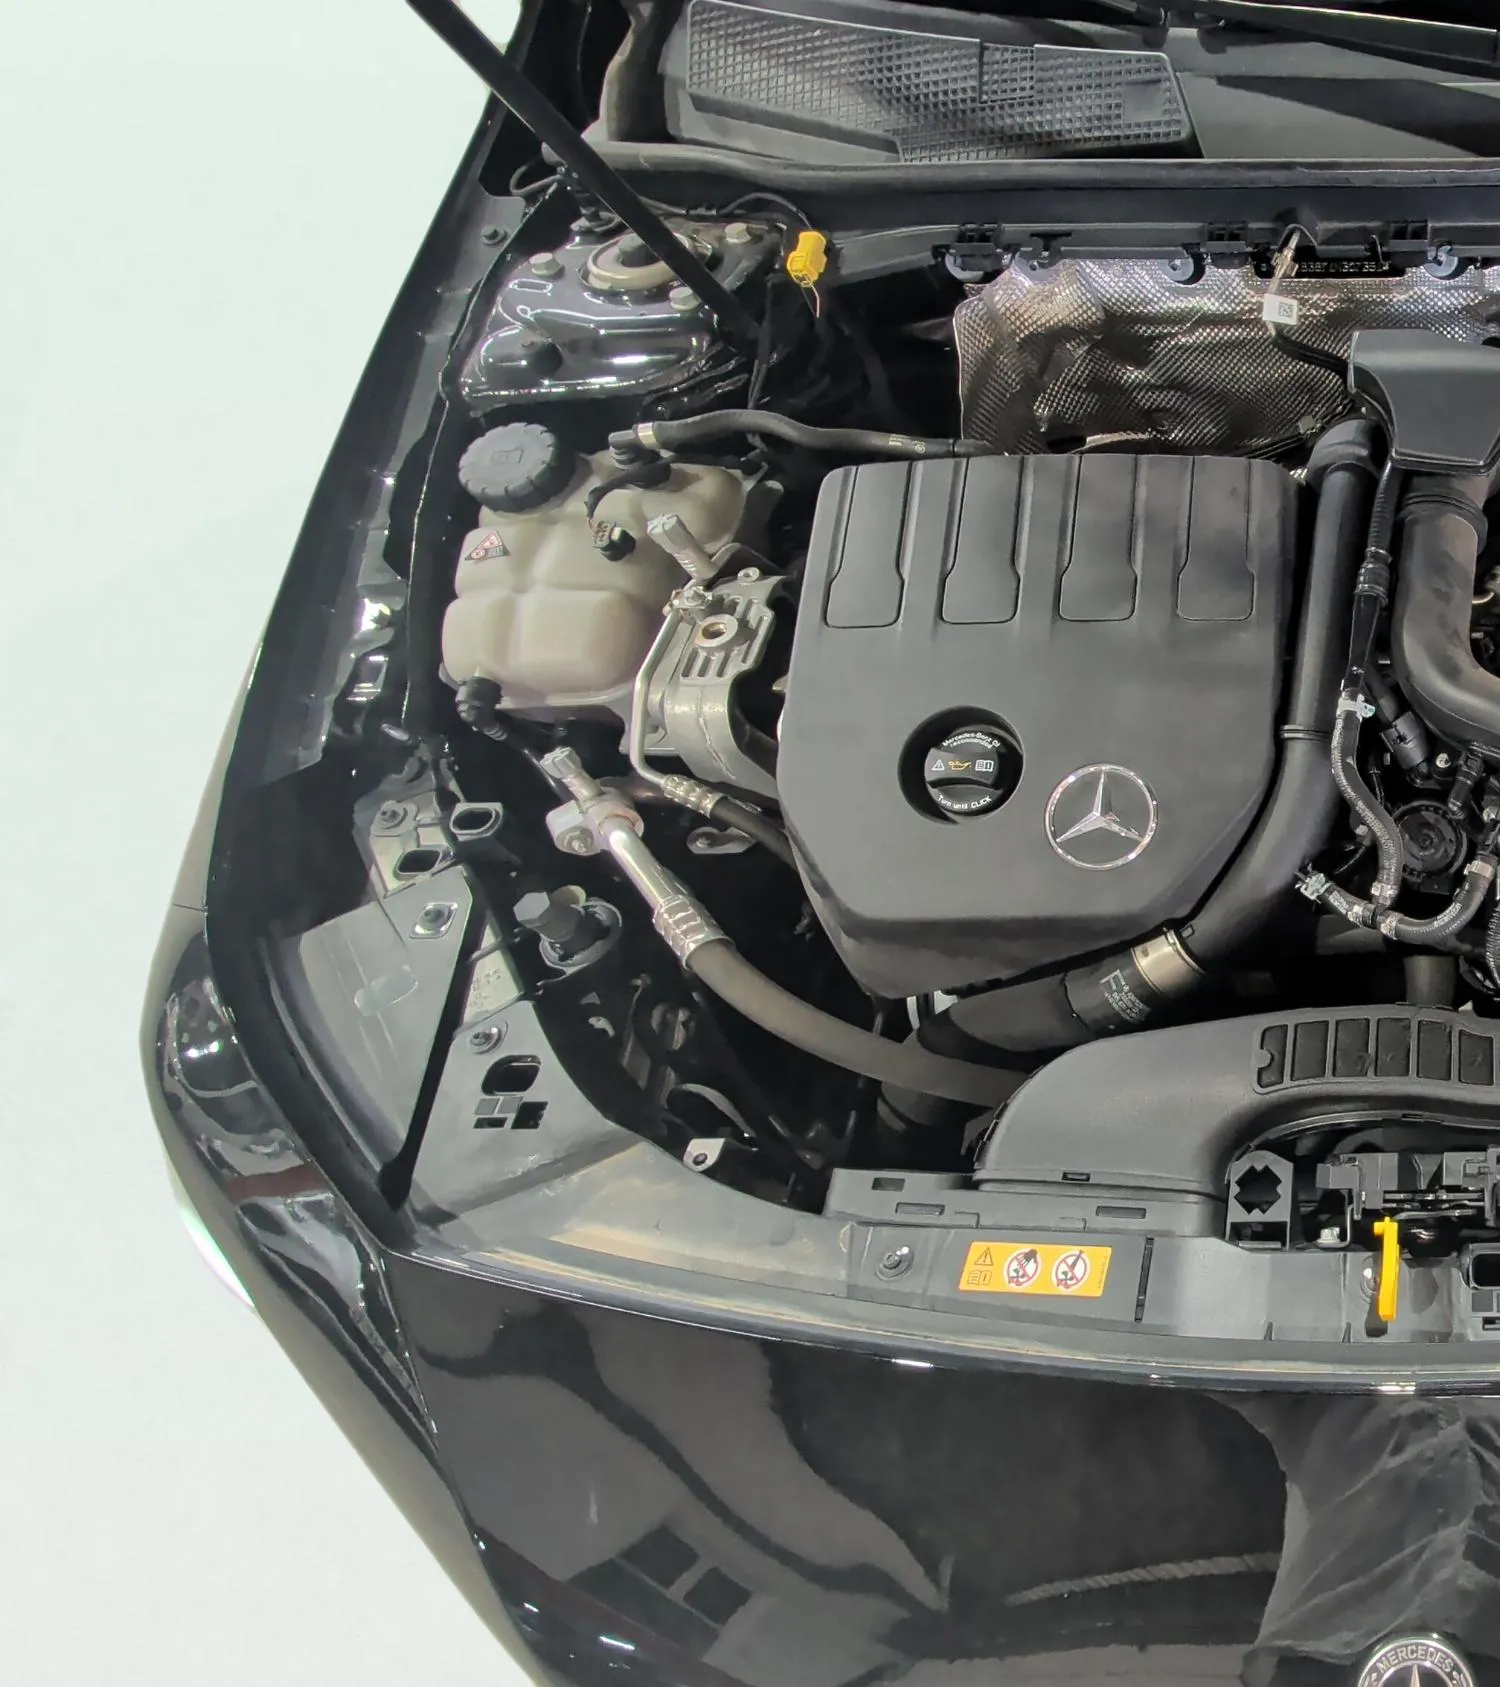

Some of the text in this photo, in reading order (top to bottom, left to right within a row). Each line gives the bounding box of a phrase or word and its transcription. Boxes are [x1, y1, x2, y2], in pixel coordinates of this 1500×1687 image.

[942, 732, 992, 747] Mercedes-Benz
[938, 794, 952, 807] Turn
[970, 795, 993, 809] CLICK
[1375, 1644, 1454, 1673] MERCEDES
